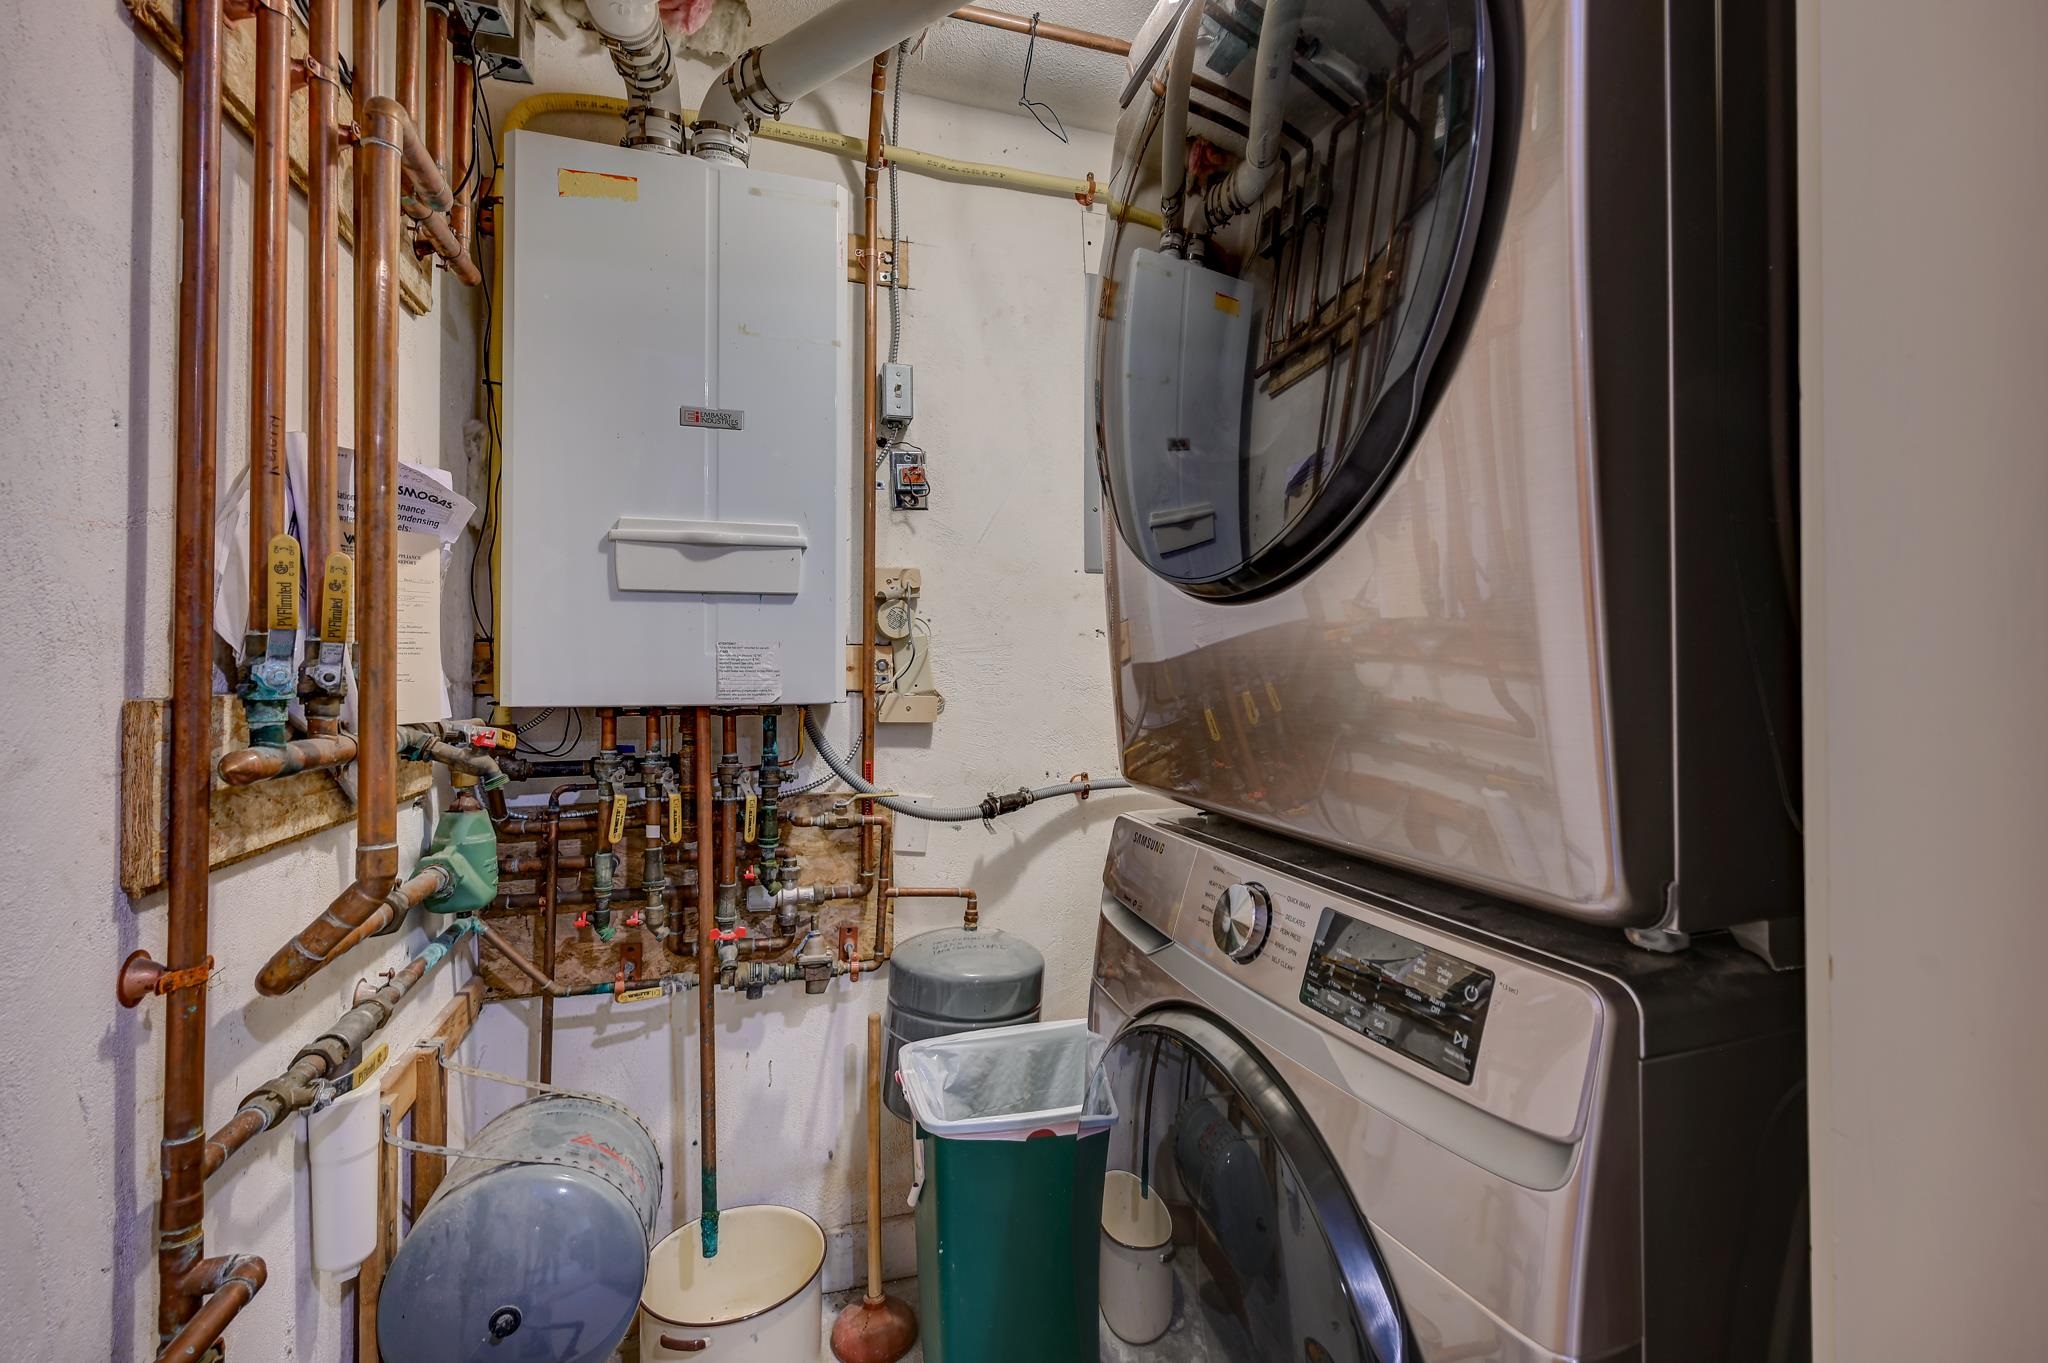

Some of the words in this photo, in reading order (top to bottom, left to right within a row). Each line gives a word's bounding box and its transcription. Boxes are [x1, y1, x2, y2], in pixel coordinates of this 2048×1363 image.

[700, 412, 732, 420] EMBASSY
[398, 485, 453, 510] SMOGAS
[276, 582, 292, 627] PVFlimited
[328, 598, 343, 638] PVFlimited
[1133, 831, 1165, 854] SAMSUNG
[1285, 914, 1306, 928] DELICATES
[1437, 966, 1452, 979] Delay
[1405, 988, 1422, 1002] Steam
[1429, 996, 1446, 1008] Alarm
[1430, 1006, 1441, 1016] Off
